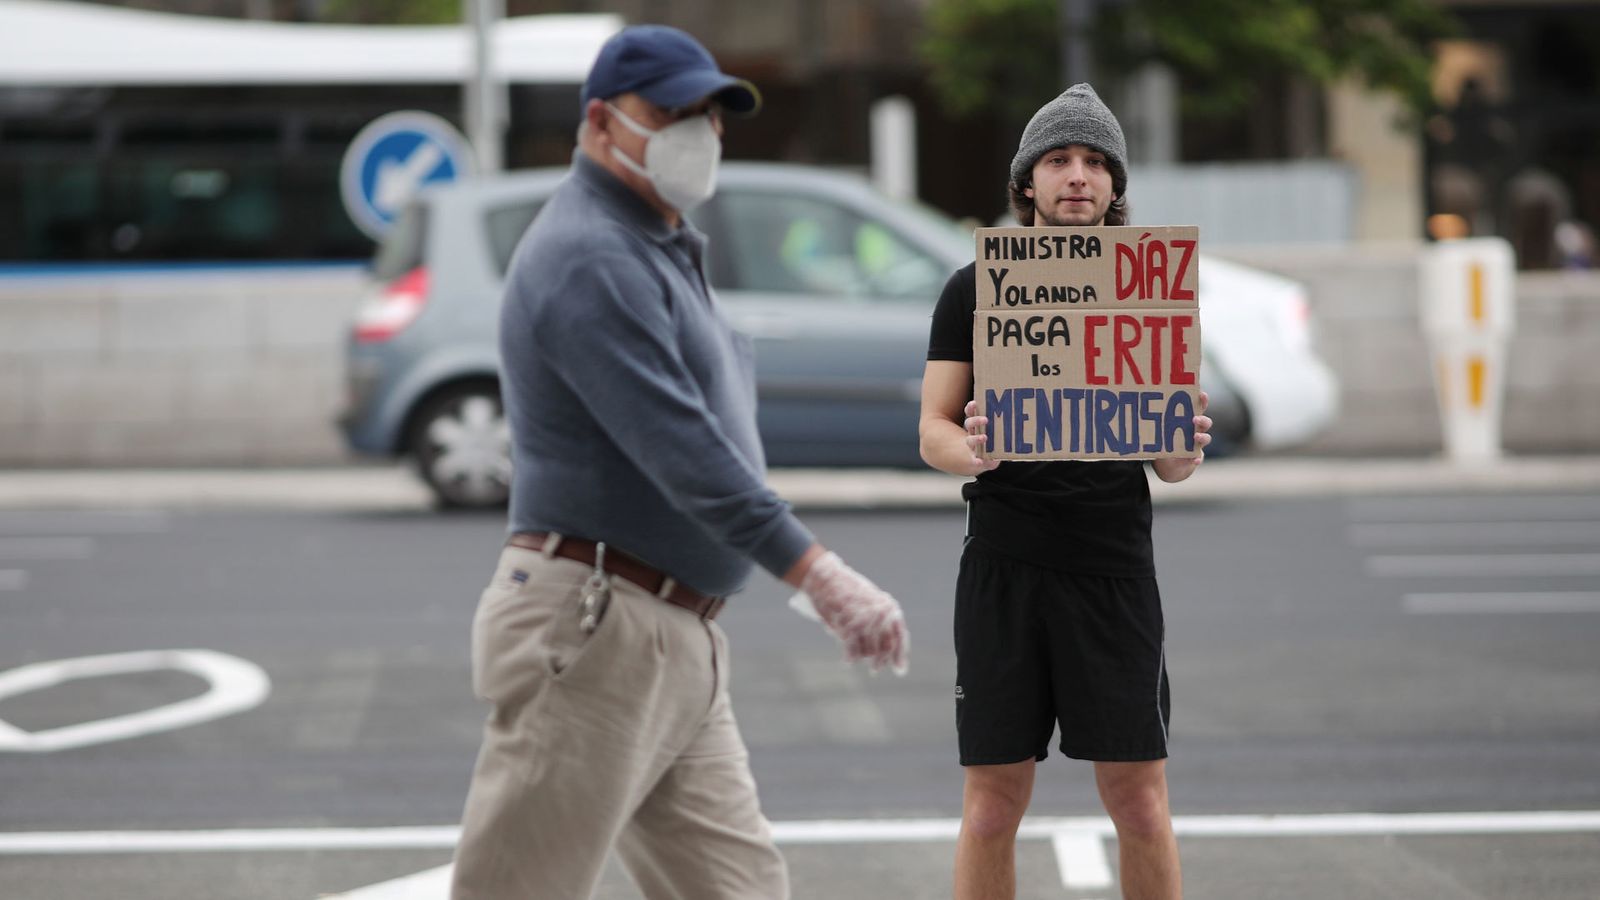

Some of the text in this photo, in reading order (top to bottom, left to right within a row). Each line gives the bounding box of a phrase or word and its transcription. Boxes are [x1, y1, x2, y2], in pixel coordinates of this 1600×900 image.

[984, 234, 1101, 260] MINISTRA
[1115, 232, 1197, 300] DÍAZ
[988, 268, 1097, 307] YOLANDA
[987, 315, 1070, 347] PAGA
[1084, 315, 1196, 385] ERTE
[1031, 353, 1061, 377] los
[985, 387, 1195, 456] MENTIROSA
